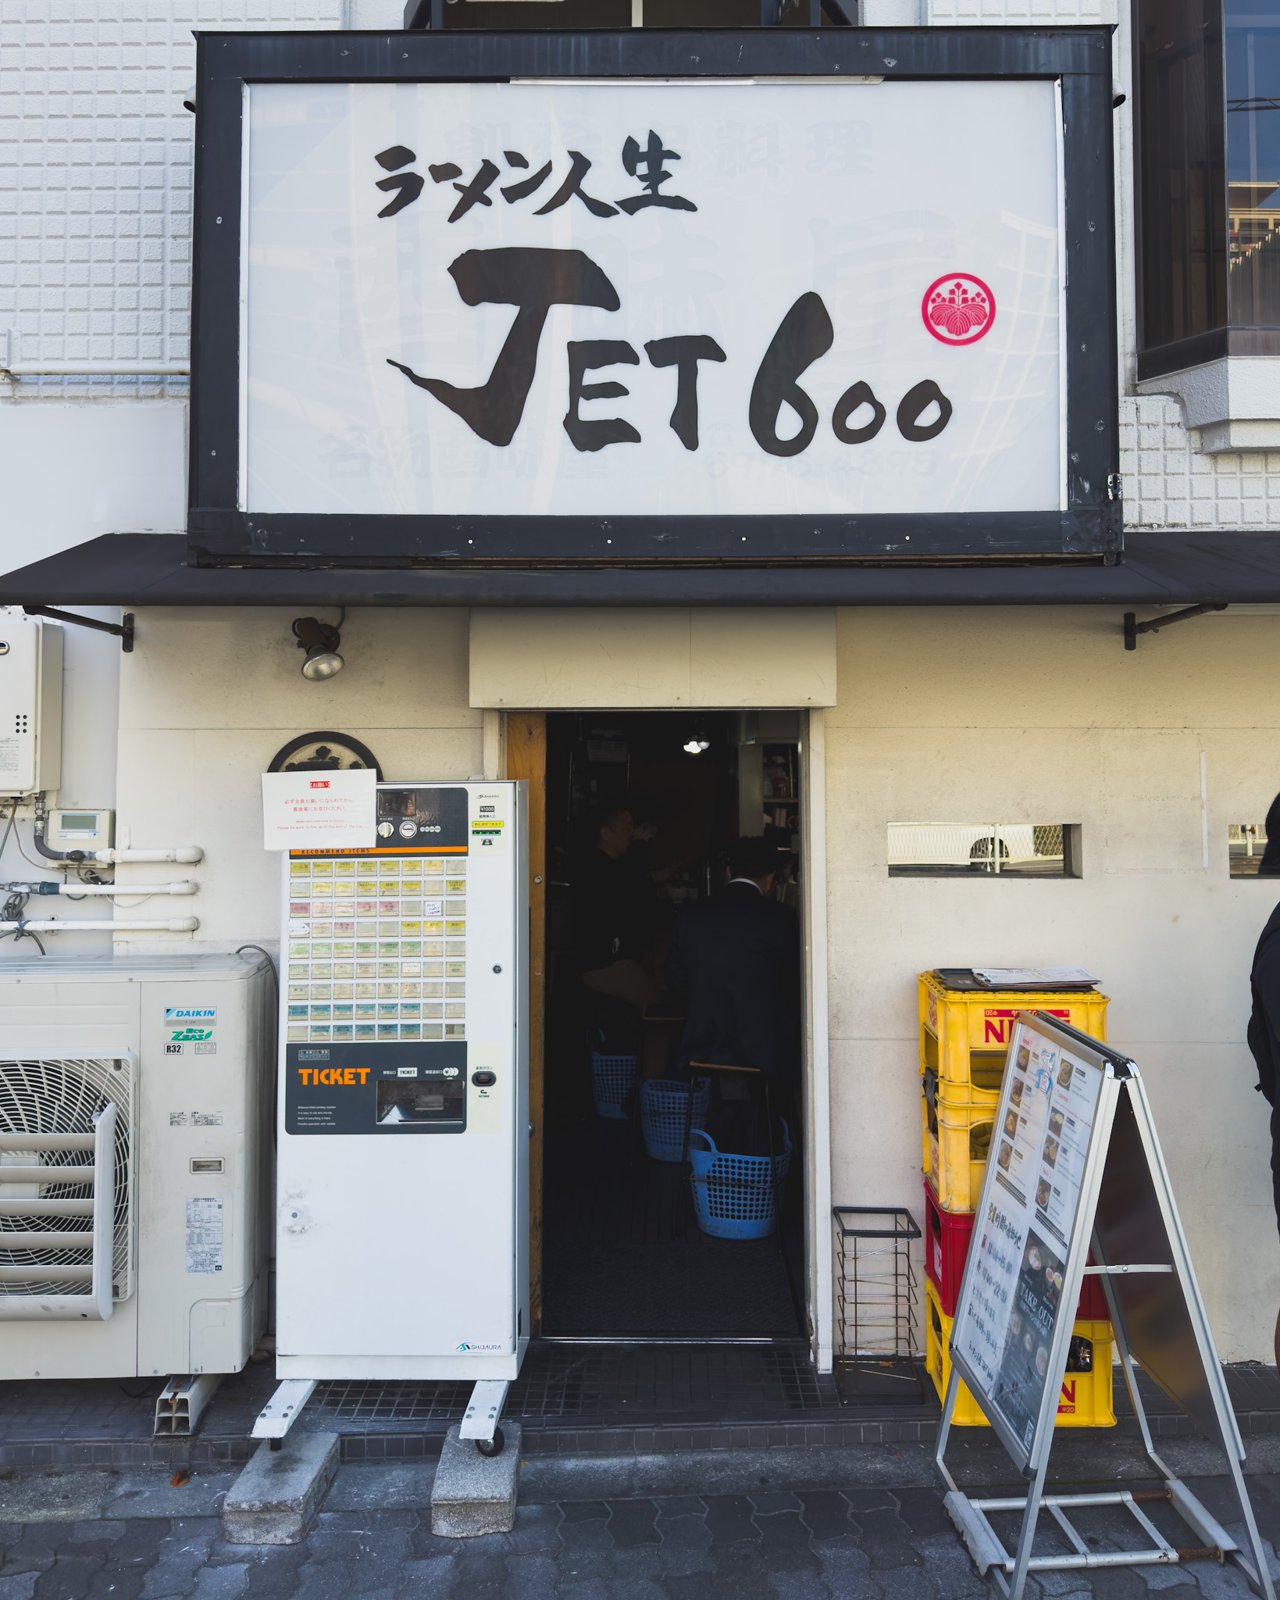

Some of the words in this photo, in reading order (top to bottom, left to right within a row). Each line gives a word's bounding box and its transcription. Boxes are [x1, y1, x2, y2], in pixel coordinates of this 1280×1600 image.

[375, 130, 697, 223] ラーメン人生
[387, 247, 726, 452] JET
[749, 291, 952, 457] 600
[176, 1009, 216, 1017] DAIKIN
[166, 1045, 182, 1053] R32
[298, 1067, 371, 1086] TICKET
[1019, 1281, 1037, 1312] TAKE
[1037, 1304, 1053, 1332] OUT
